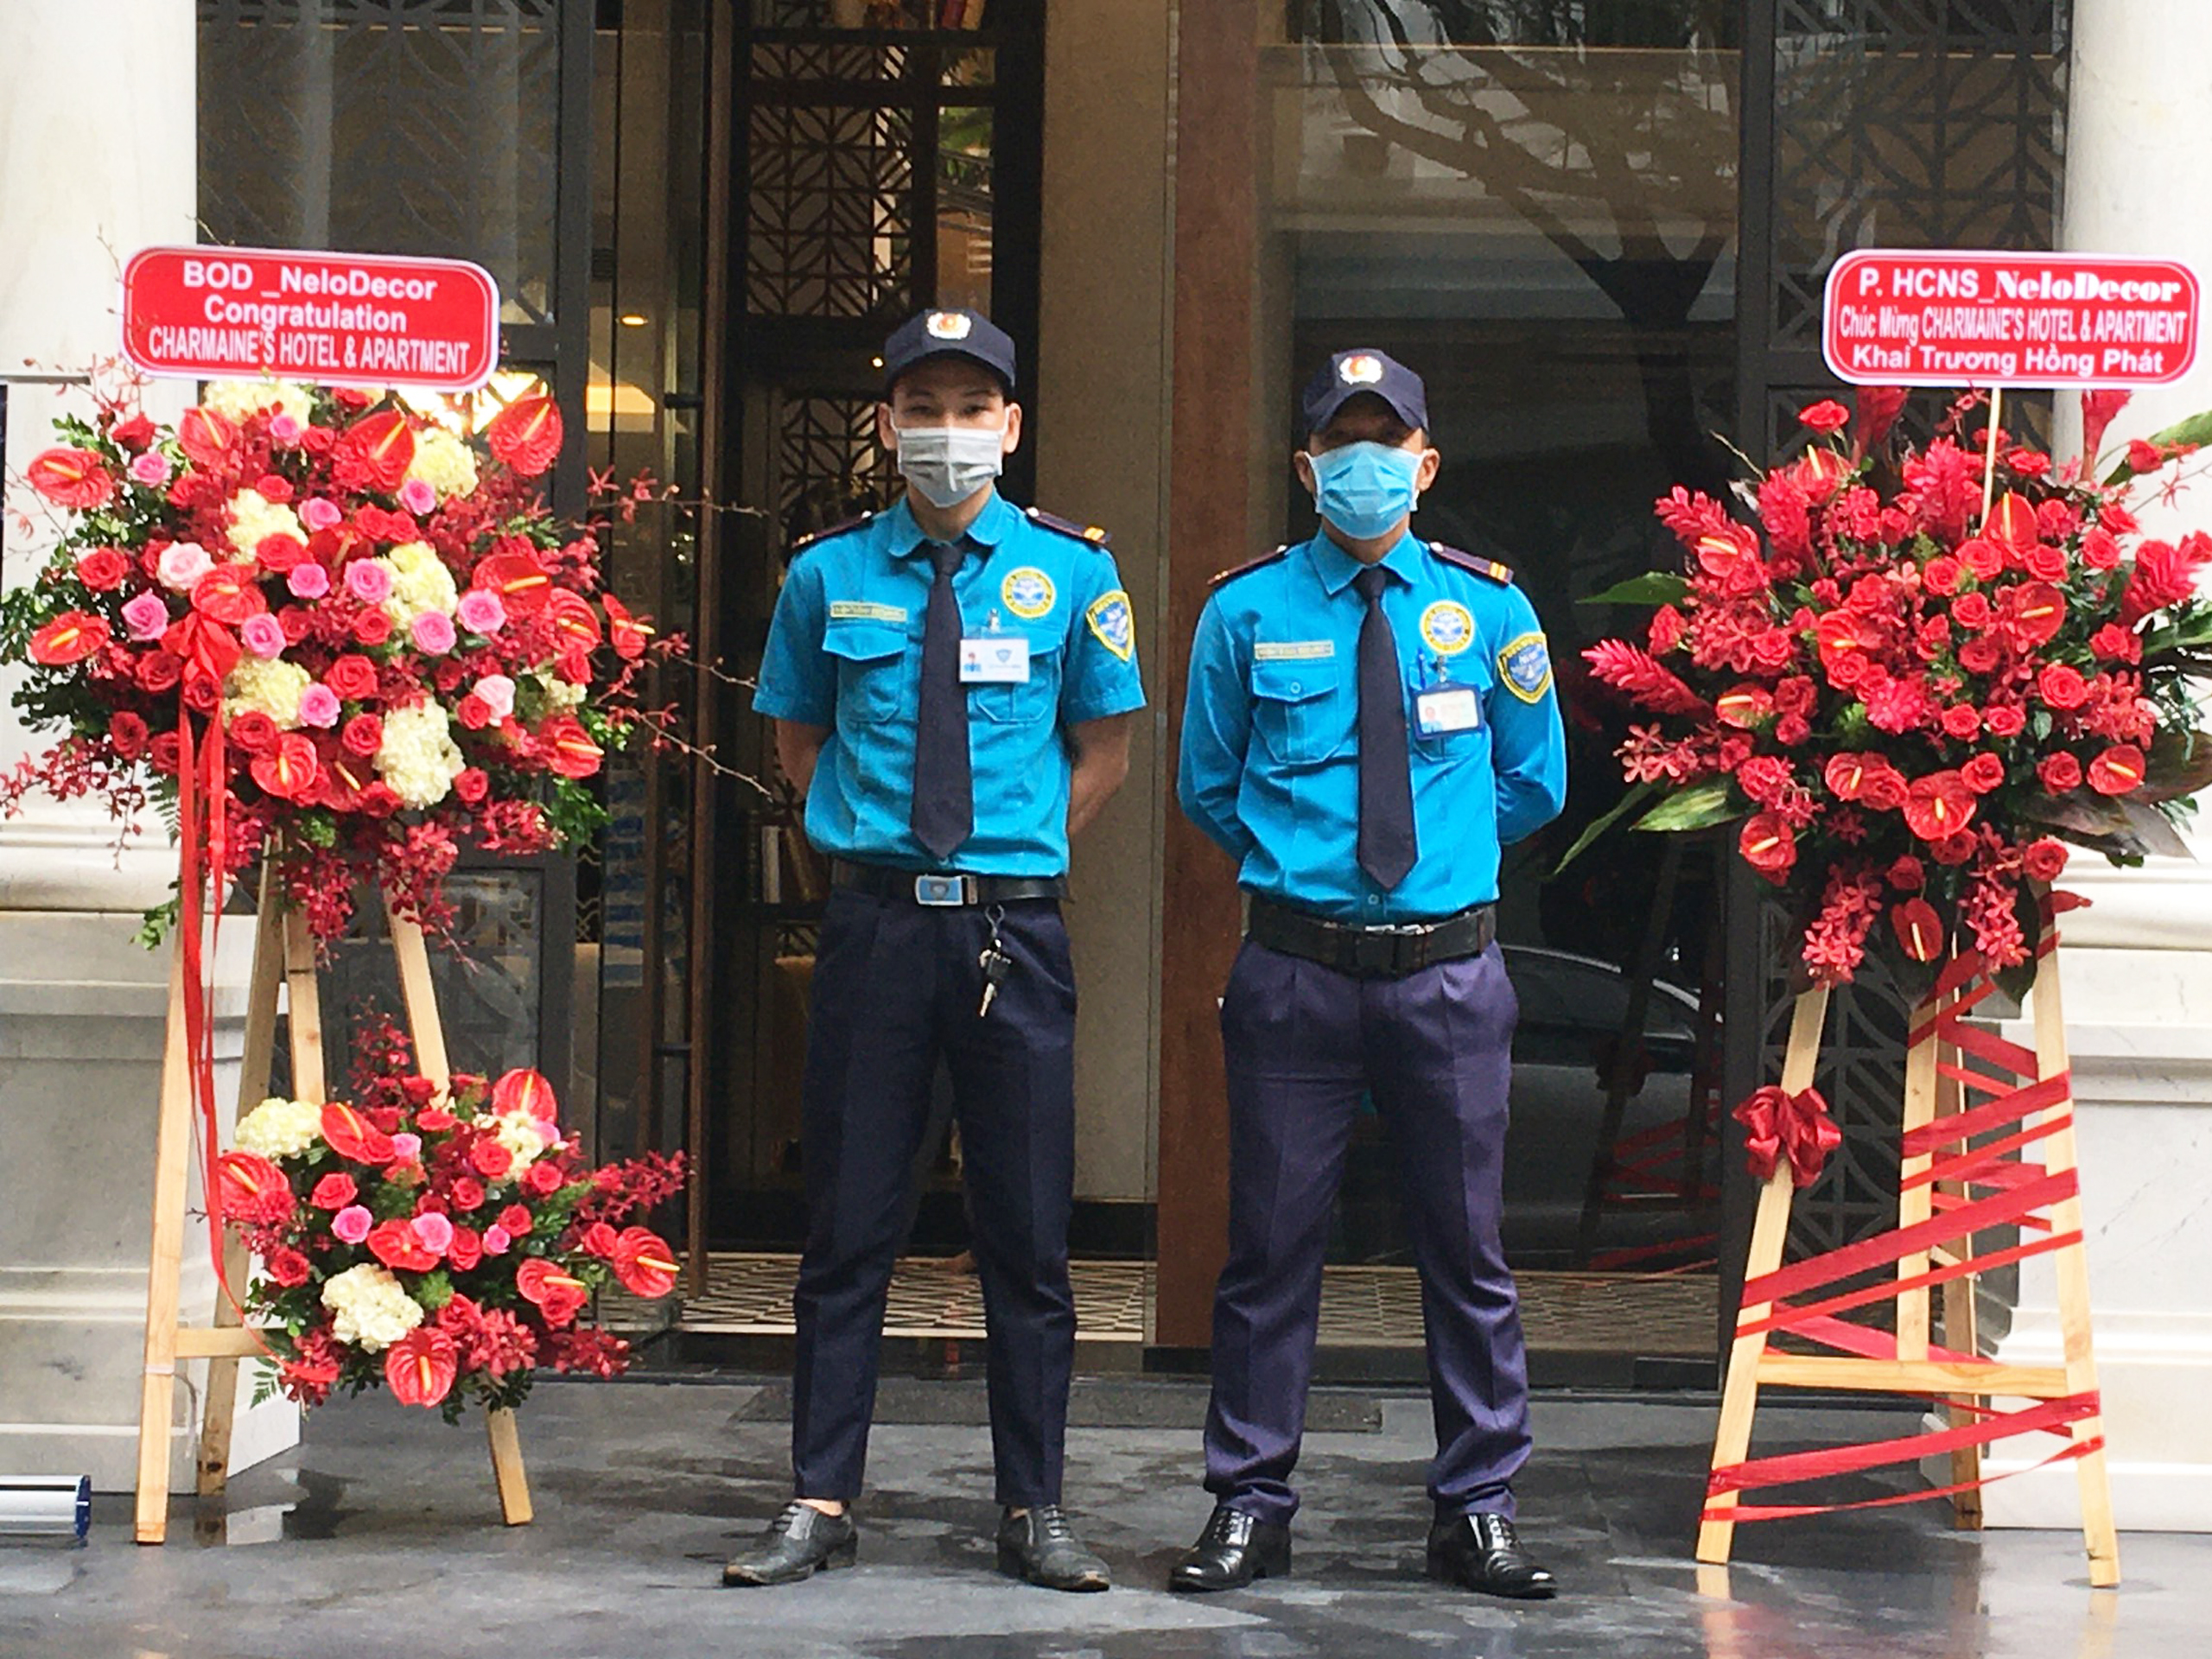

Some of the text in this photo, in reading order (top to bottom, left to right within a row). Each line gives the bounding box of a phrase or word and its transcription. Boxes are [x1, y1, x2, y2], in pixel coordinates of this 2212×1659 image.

[183, 260, 253, 290] BOD
[1859, 267, 1883, 296] P.
[204, 295, 407, 333] Congratulation
[1840, 305, 2188, 346] Chúc Mừng CHARMAINE'S HOTEL & APARTMENT
[149, 326, 470, 375] CHARMAINE'S HOTEL & APARTMENT
[1853, 344, 1911, 369] Khai
[2025, 343, 2094, 378] Hồng
[2103, 348, 2164, 373] Phát
